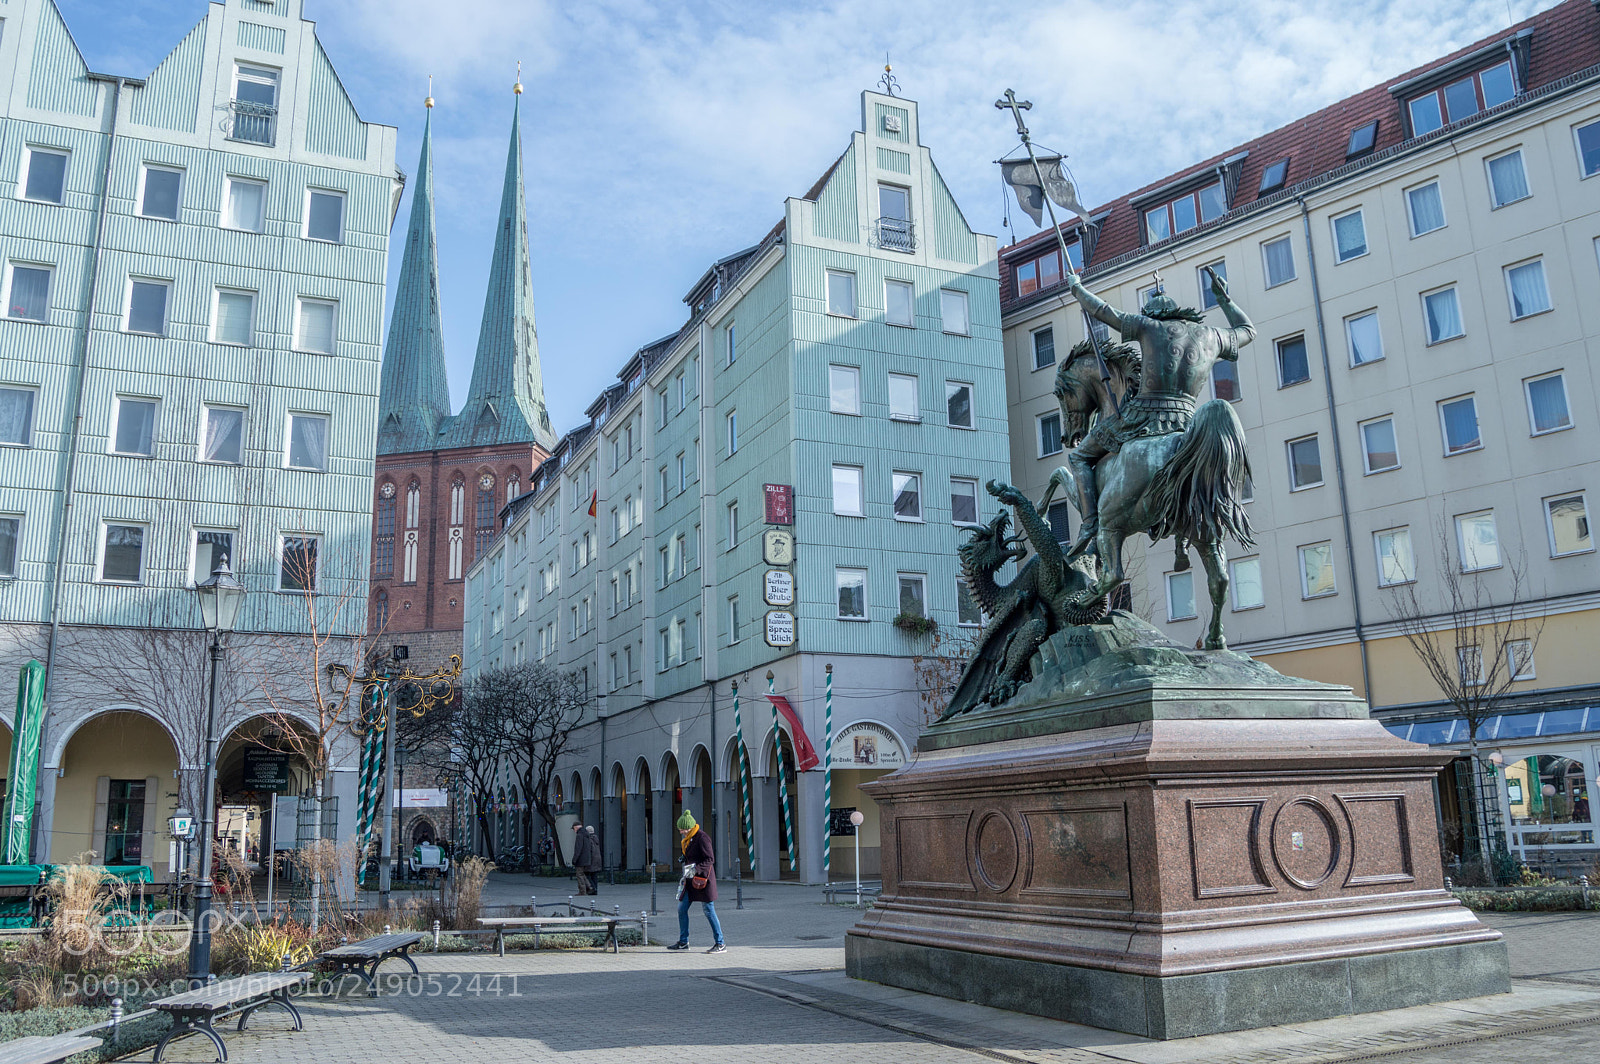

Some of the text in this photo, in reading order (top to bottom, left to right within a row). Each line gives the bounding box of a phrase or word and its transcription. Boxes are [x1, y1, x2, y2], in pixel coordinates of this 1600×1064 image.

[769, 625, 792, 634] Spree
[771, 634, 791, 642] Blick
[836, 723, 895, 744] ZILLE GASTRONOMIE
